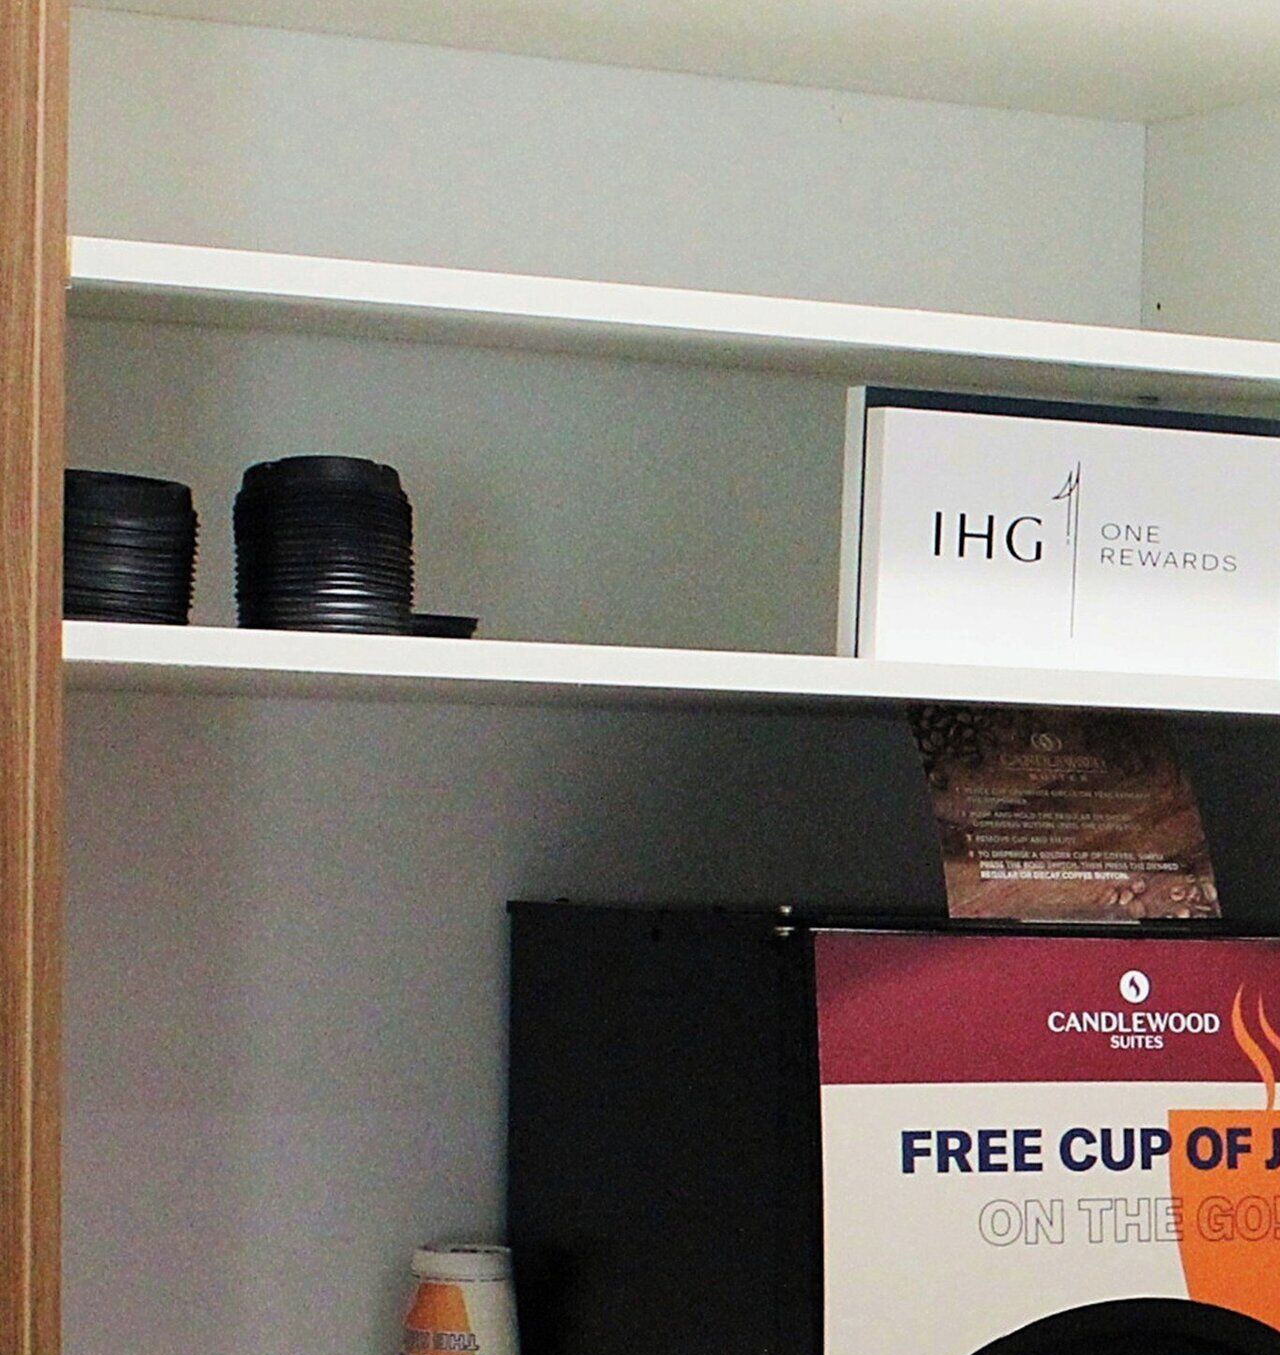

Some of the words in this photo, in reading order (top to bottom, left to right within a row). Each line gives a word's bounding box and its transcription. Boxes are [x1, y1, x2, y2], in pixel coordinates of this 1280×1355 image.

[933, 511, 1045, 563] IHG
[1100, 521, 1162, 545] ONE
[1100, 546, 1239, 573] REWARDS
[1047, 1011, 1221, 1035] CANDLEWOOD
[1110, 1035, 1164, 1050] SUITES
[901, 1129, 1044, 1175] FREE
[1058, 1127, 1172, 1172] CUP
[1186, 1127, 1253, 1170] OF
[978, 1198, 1064, 1247] ON
[1078, 1196, 1184, 1243] THE
